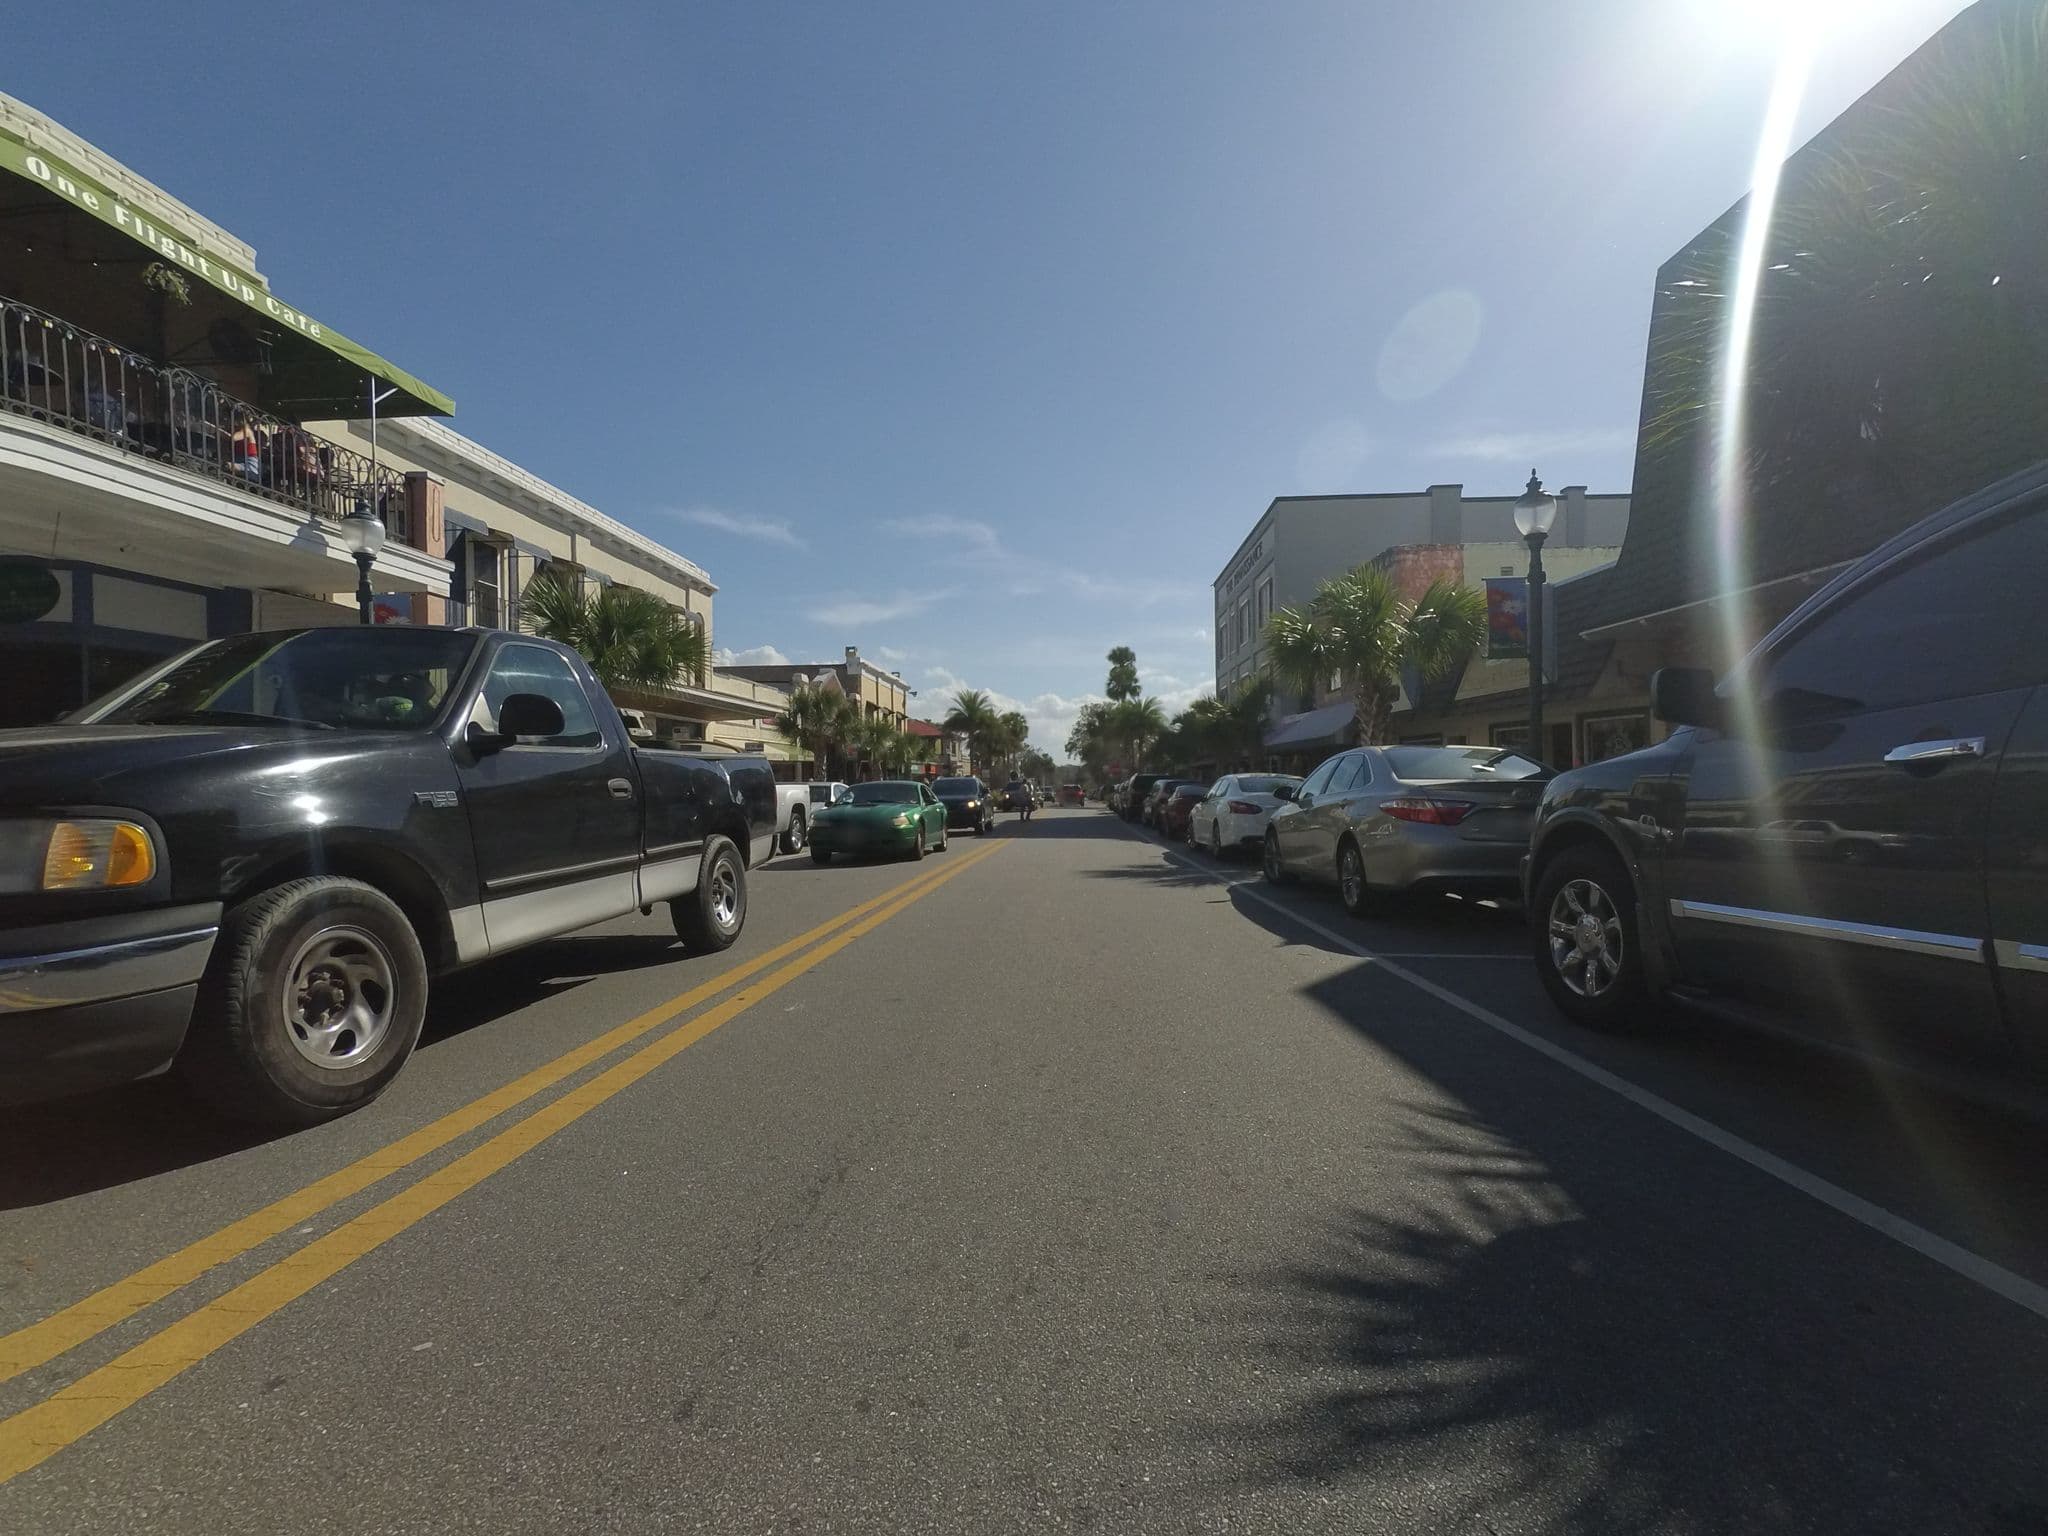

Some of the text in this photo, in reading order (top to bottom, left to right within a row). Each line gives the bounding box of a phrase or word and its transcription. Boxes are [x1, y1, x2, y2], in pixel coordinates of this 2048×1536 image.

[26, 156, 100, 211] One
[114, 204, 211, 277] Flight
[222, 269, 255, 302] Up
